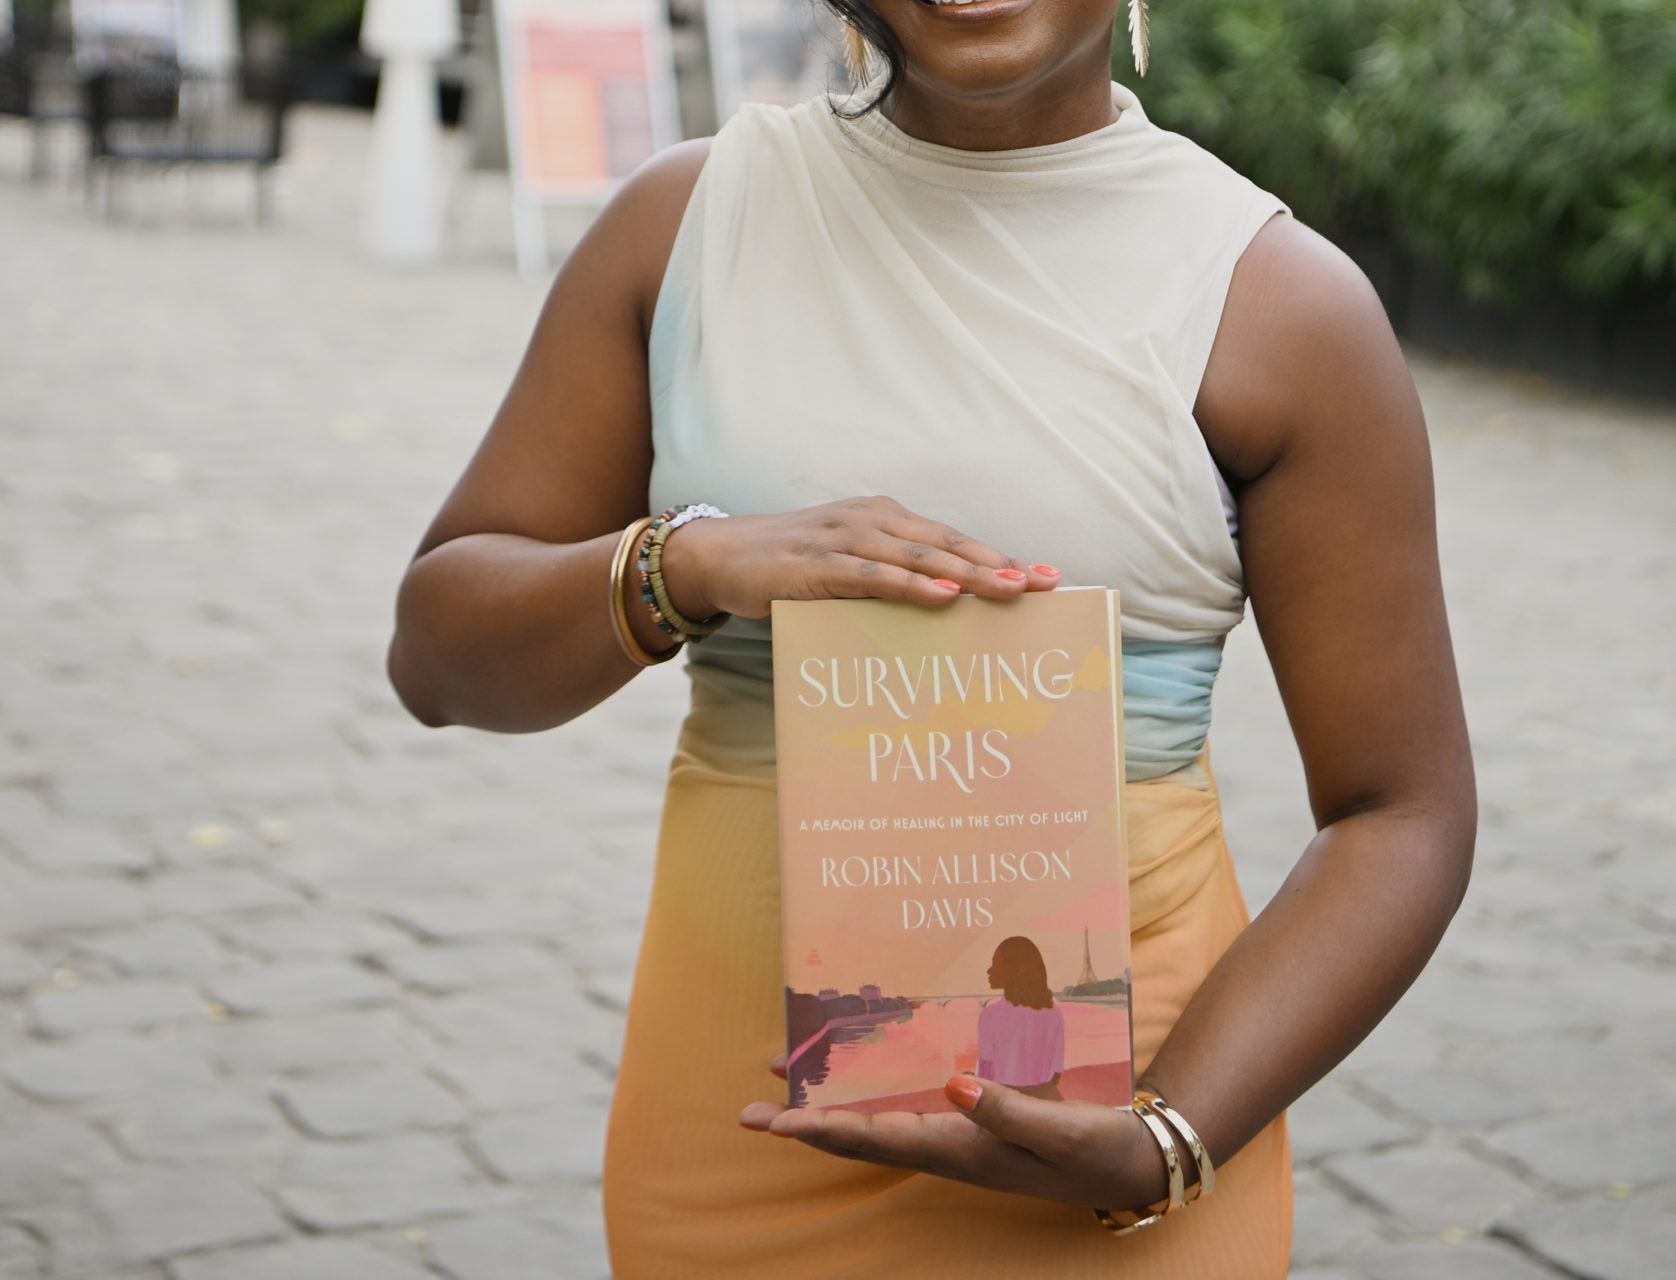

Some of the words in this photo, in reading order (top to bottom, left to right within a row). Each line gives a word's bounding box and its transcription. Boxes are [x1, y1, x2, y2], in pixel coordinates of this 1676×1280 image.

[797, 649, 1074, 719] SURVIVING
[869, 729, 1011, 794] PARIS
[799, 820, 808, 831] A
[812, 819, 865, 832] MEMOIR
[870, 818, 888, 831] OF
[893, 816, 945, 830] HEALING
[950, 816, 963, 828] IN
[967, 815, 990, 827] THE
[995, 814, 1025, 827] CITY
[1030, 812, 1049, 825] OF
[1054, 810, 1088, 824] LIGHT
[821, 856, 922, 887] ROBIN
[932, 850, 1071, 885] ALLISON
[902, 898, 993, 929] DAVIS
